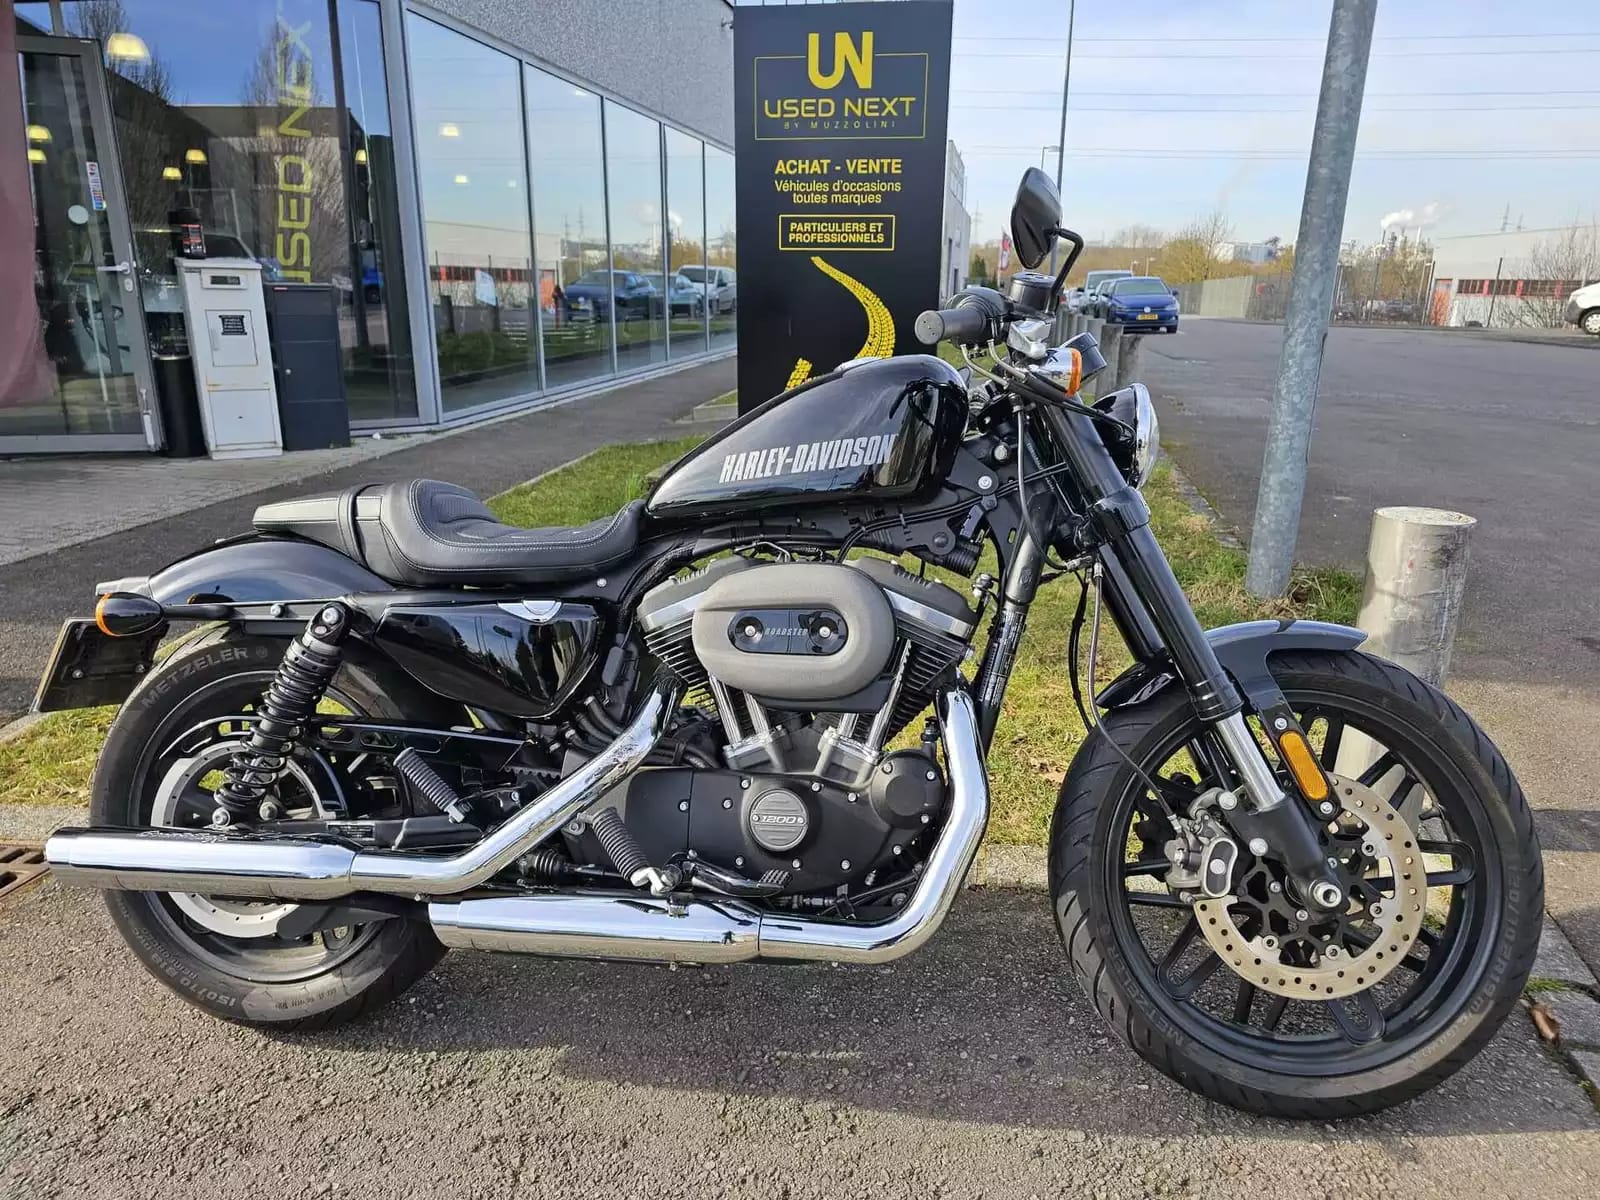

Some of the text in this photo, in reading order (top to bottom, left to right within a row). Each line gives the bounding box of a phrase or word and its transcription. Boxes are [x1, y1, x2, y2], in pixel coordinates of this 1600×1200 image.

[807, 31, 874, 90] UN
[764, 97, 916, 118] USED NEXT
[783, 120, 896, 130] BY MUZZOLINI
[775, 159, 831, 174] ACHAT
[846, 158, 902, 174] VENTE
[774, 180, 902, 192] Véhicules d'occasions
[793, 193, 882, 206] toutes marques
[789, 222, 884, 233] PARTICULIERS ET
[788, 233, 885, 243] PROFESSIONNELS
[718, 433, 900, 484] HARLEY-DAVIDSON
[764, 628, 809, 637] ROADSTER
[140, 646, 249, 709] METZELER
[760, 815, 797, 825] 1200
[1107, 944, 1184, 1047] METZELER
